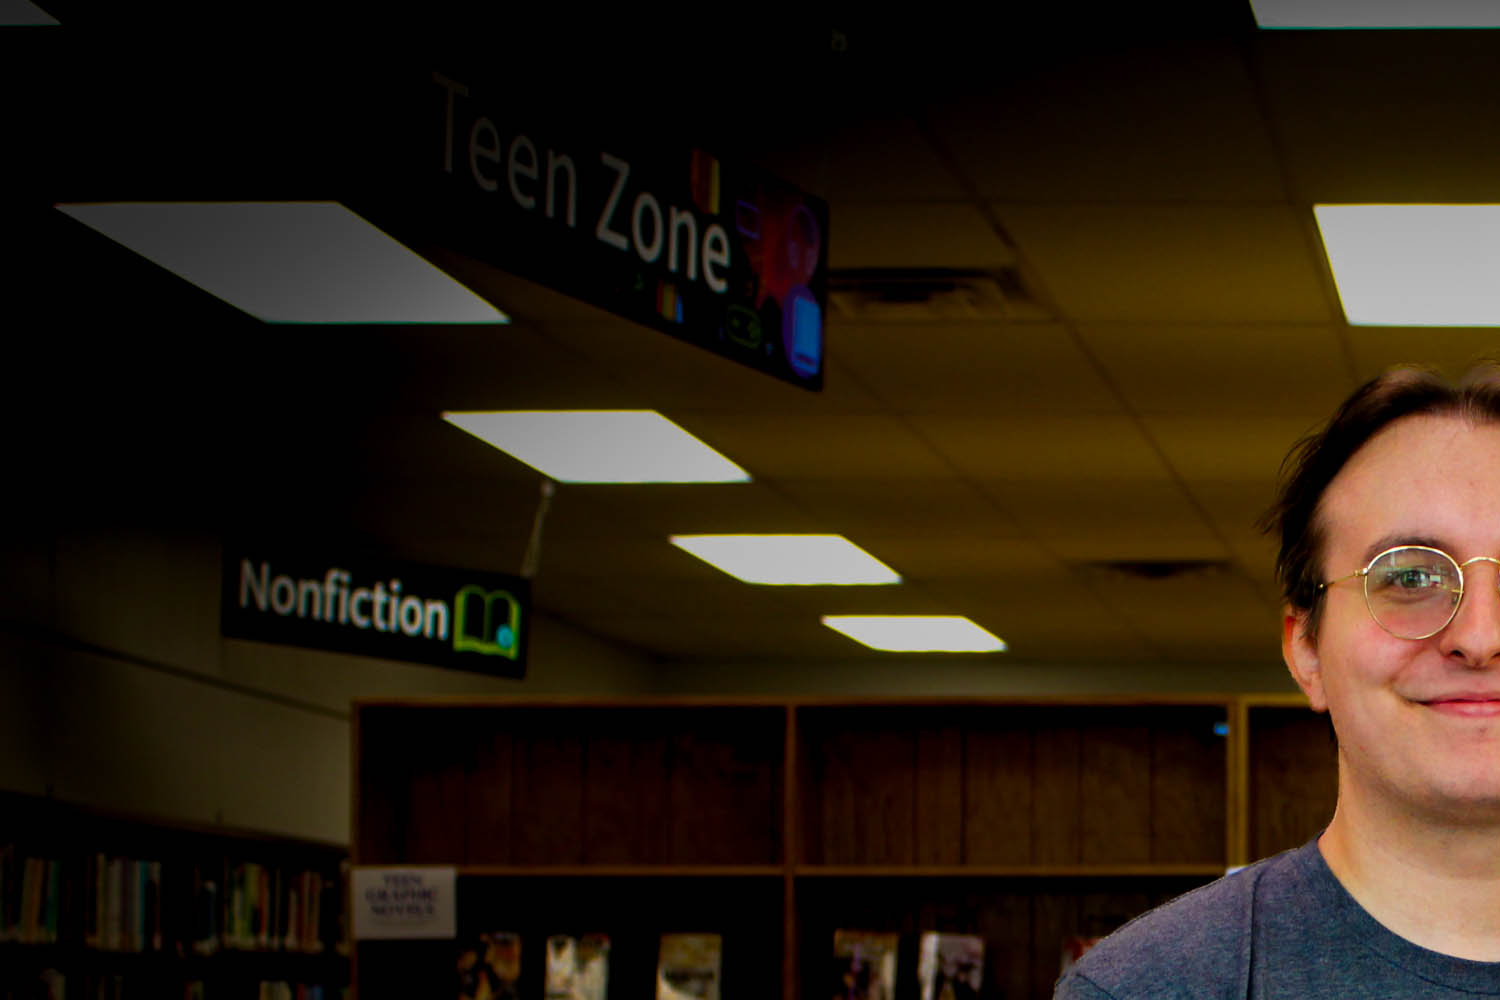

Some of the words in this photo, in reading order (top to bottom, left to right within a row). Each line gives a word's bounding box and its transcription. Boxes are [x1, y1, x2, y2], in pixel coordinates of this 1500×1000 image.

[431, 71, 578, 229] Teen
[594, 150, 732, 295] Zone
[238, 556, 450, 642] Nonfiction
